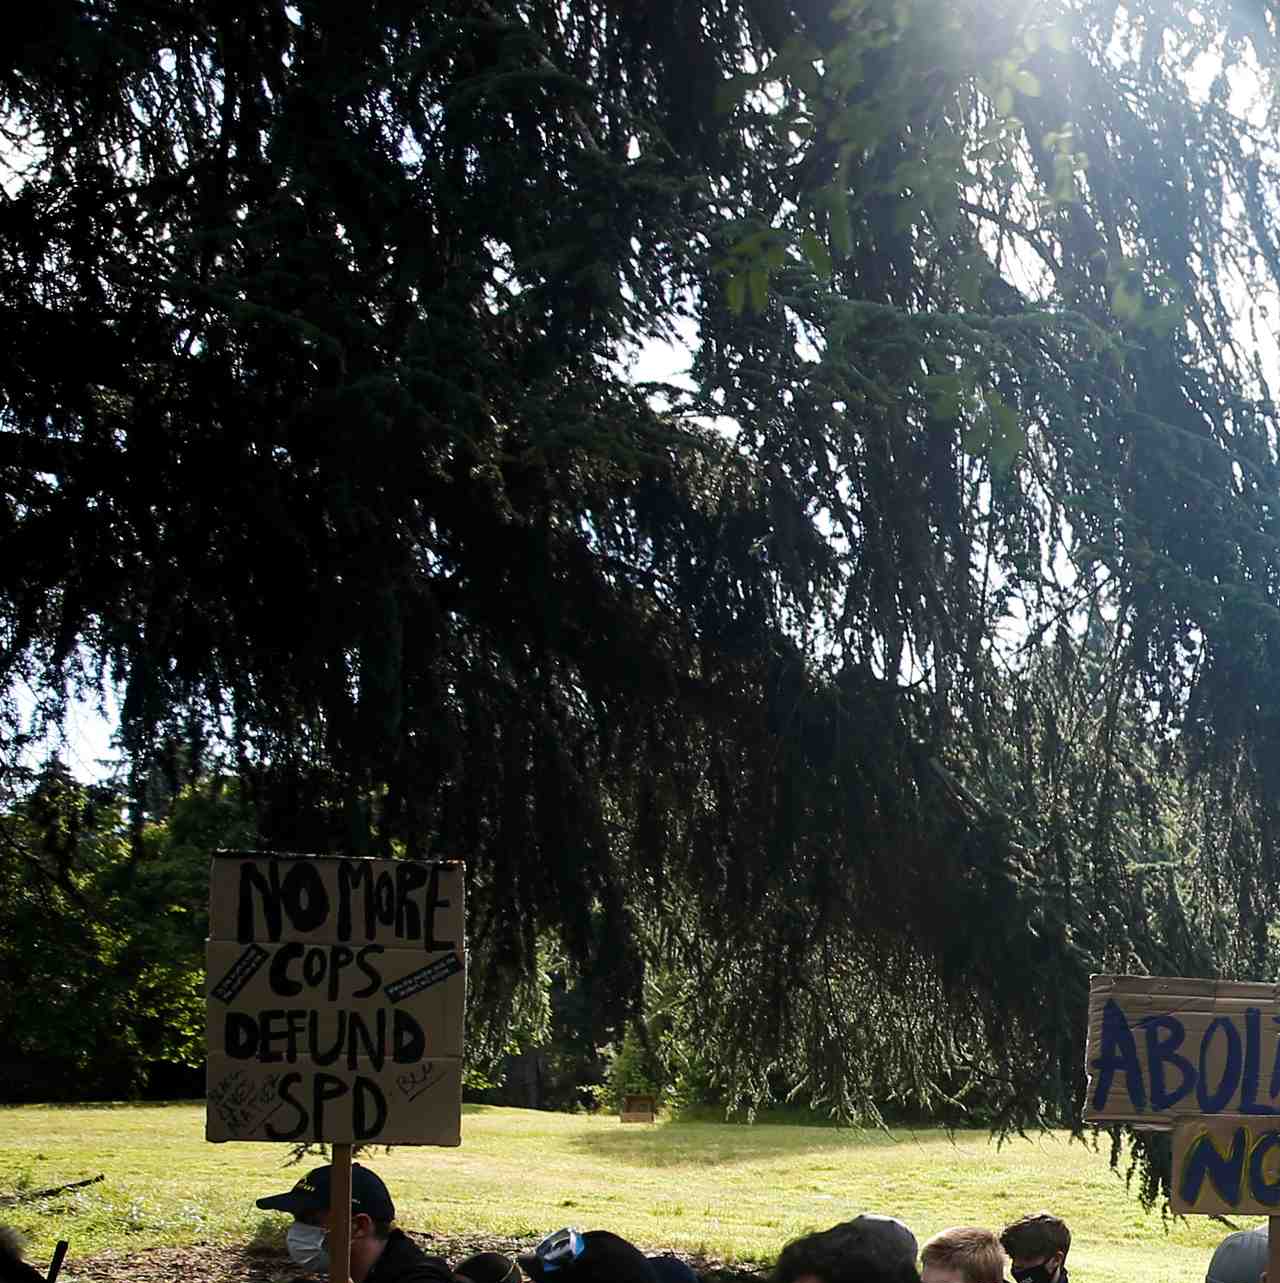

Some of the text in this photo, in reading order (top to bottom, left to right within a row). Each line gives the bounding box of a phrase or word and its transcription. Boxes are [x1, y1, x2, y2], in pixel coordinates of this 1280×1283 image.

[237, 860, 456, 953] NO MORE
[269, 943, 385, 1001] COPS
[225, 1008, 426, 1072] DEFUND
[265, 1071, 389, 1141] SPD
